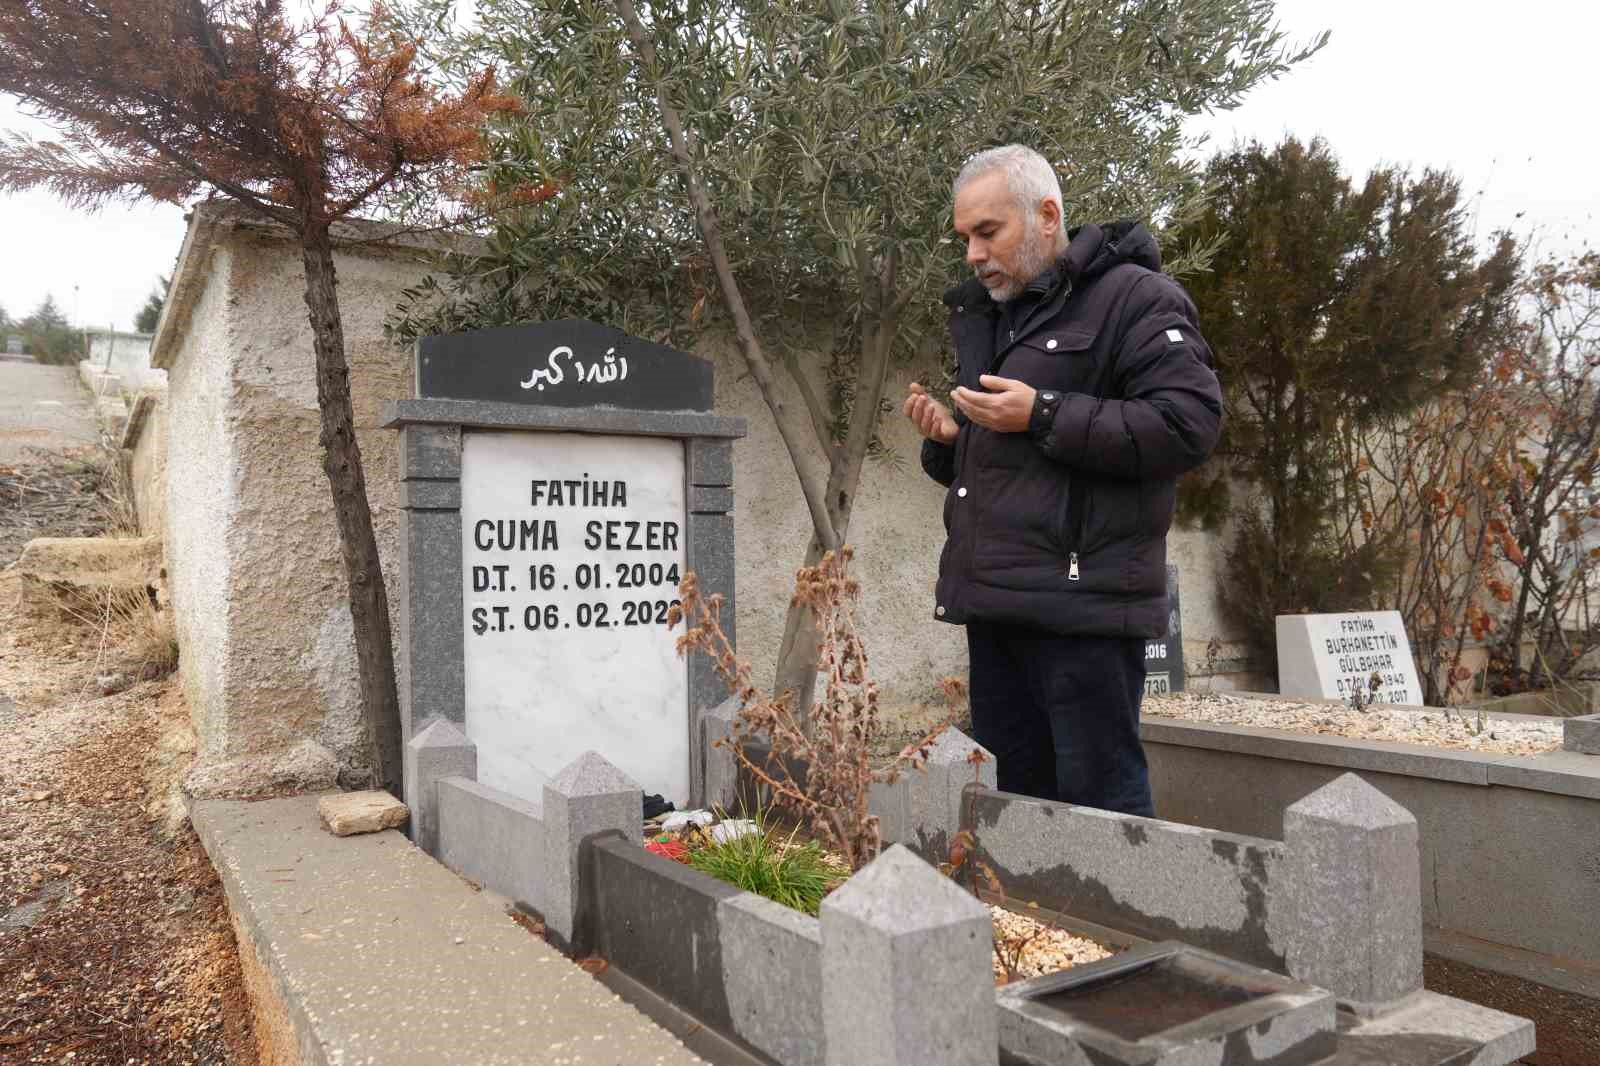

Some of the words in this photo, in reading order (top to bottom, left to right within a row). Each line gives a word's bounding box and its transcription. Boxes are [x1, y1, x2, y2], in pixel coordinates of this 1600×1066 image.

[532, 473, 626, 507] FATİHA
[475, 520, 558, 551] CUMA
[585, 521, 678, 550] SEZER
[473, 566, 515, 592] D.T.
[1341, 616, 1375, 633] FATİHA
